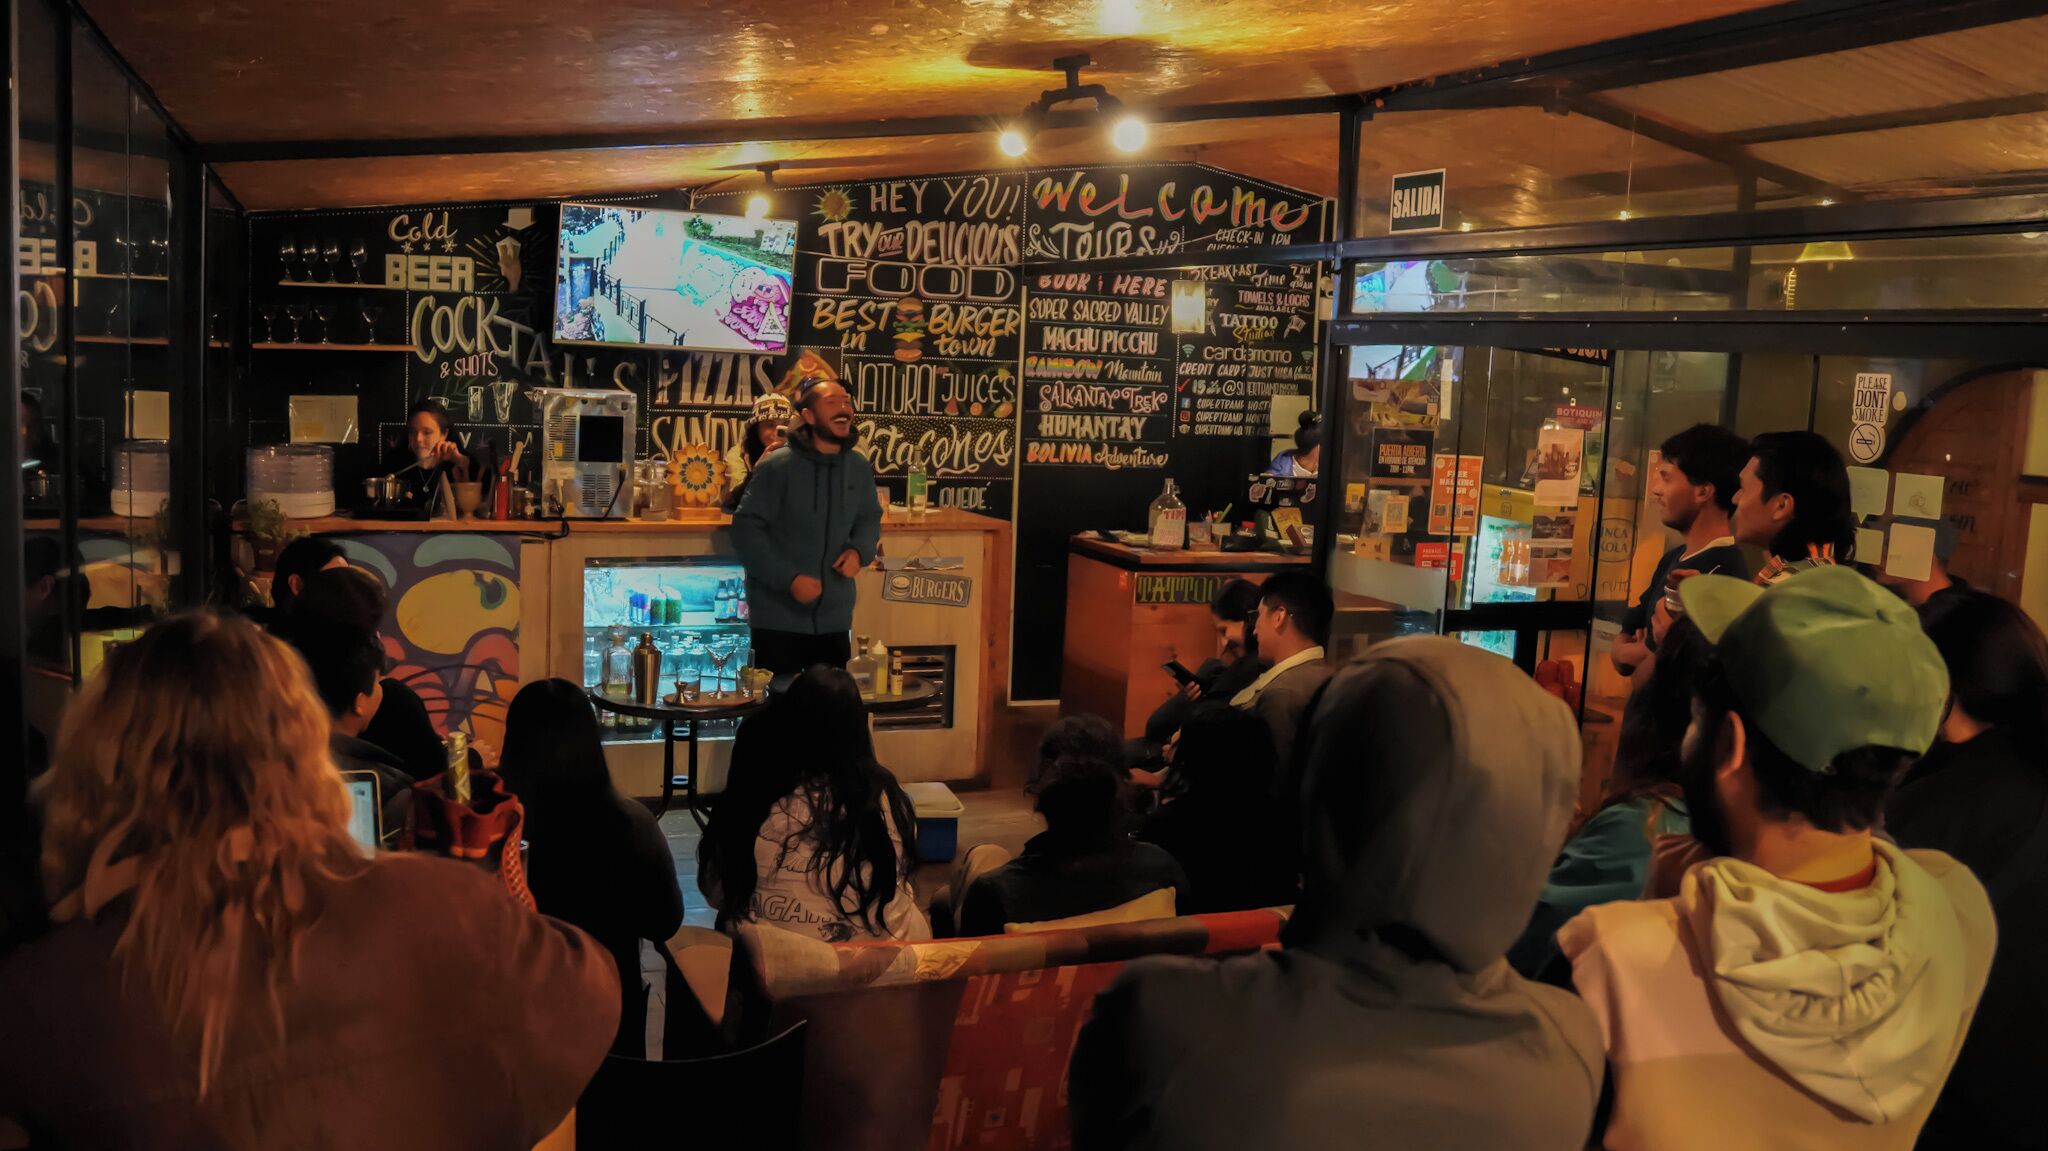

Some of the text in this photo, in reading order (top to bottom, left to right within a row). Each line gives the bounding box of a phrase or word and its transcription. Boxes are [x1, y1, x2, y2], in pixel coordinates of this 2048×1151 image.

[870, 177, 1021, 221] HEY YOU!
[1032, 171, 1309, 232] Welcome
[1393, 185, 1441, 219] SALIDA
[388, 211, 458, 241] Cold
[1050, 221, 1156, 260] TOURS
[1215, 229, 1264, 244] CHECK-IN
[818, 221, 883, 259] TRY
[905, 220, 1020, 266] DELICIOUS
[385, 253, 475, 292] BEER
[816, 257, 1014, 302] FOOD
[1038, 273, 1168, 297] BOOK HERE
[1029, 297, 1170, 326] SUPER SACRED VALLEY
[1238, 289, 1274, 306] TOWELS
[1255, 305, 1297, 314] AVAILABLE
[812, 298, 1021, 338] BEST BURGER
[1219, 312, 1279, 329] TATTOO
[840, 328, 997, 358] in town
[1042, 325, 1159, 356] MACHU PICCHU
[439, 350, 499, 379] & SHOTS
[1104, 359, 1163, 384] Mountain
[1179, 362, 1214, 375] CREDIT
[1217, 364, 1246, 377] CARD?
[1249, 366, 1273, 379] JUST
[844, 361, 1016, 415] NATURAL JUICES
[1039, 380, 1120, 412] SALKANTAY
[1858, 375, 1888, 391] PLEASE
[1557, 407, 1603, 417] BOTIQUIN
[1856, 389, 1887, 409] DONT
[1038, 413, 1148, 441] HUMANTAY
[1196, 411, 1243, 423] SUPERTRAMP
[1854, 407, 1885, 424] SMOKE
[1026, 441, 1169, 470] BOLIVIA Adventure
[911, 575, 965, 603] BURGERS
